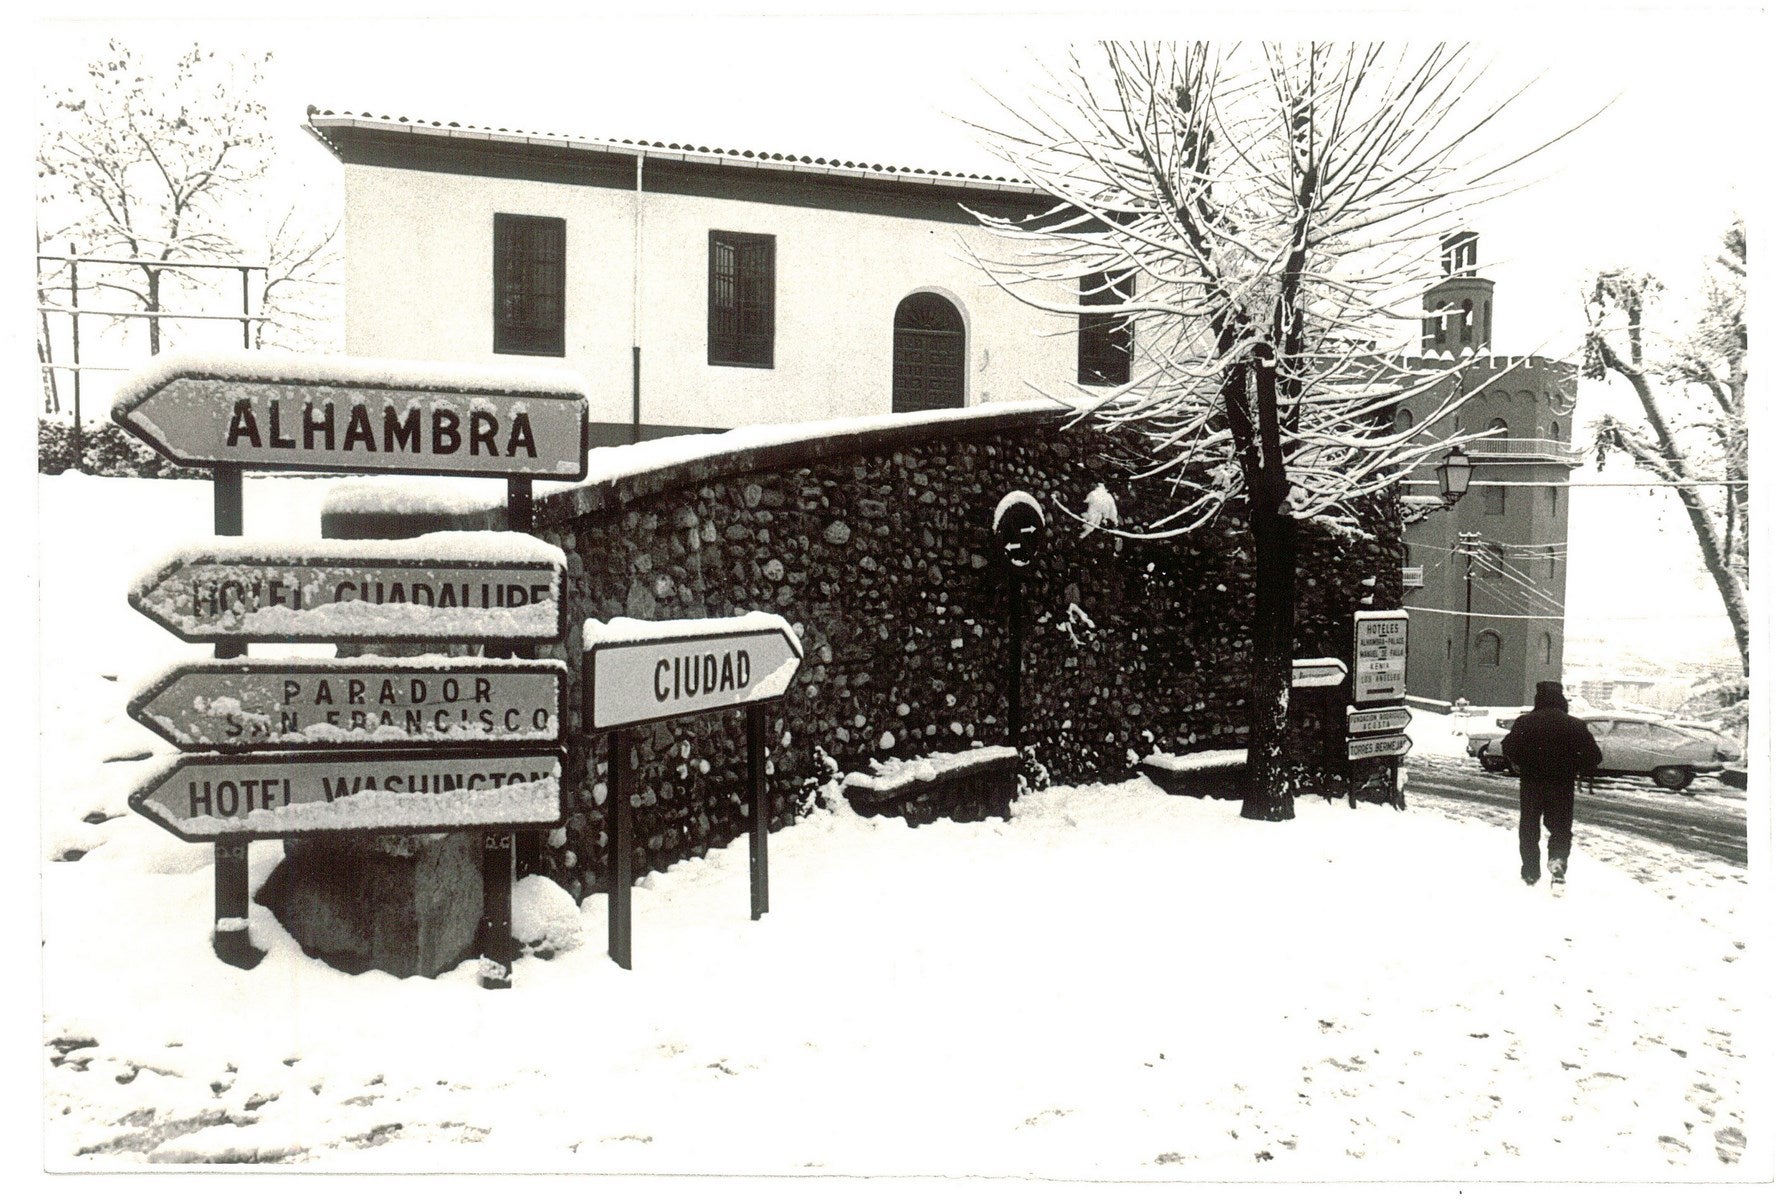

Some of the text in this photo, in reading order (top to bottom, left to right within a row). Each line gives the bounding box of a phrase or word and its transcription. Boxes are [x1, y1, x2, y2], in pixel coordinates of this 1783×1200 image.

[226, 399, 538, 459] ALHAMBRA
[1366, 623, 1399, 634] HOTELES
[654, 649, 751, 702] CIUDAD
[284, 678, 492, 706] PARADOR
[326, 708, 549, 735] FRANCISCO
[1361, 720, 1390, 730] ACOSTA
[1350, 743, 1374, 756] TORRES
[189, 779, 291, 818] HOTEL
